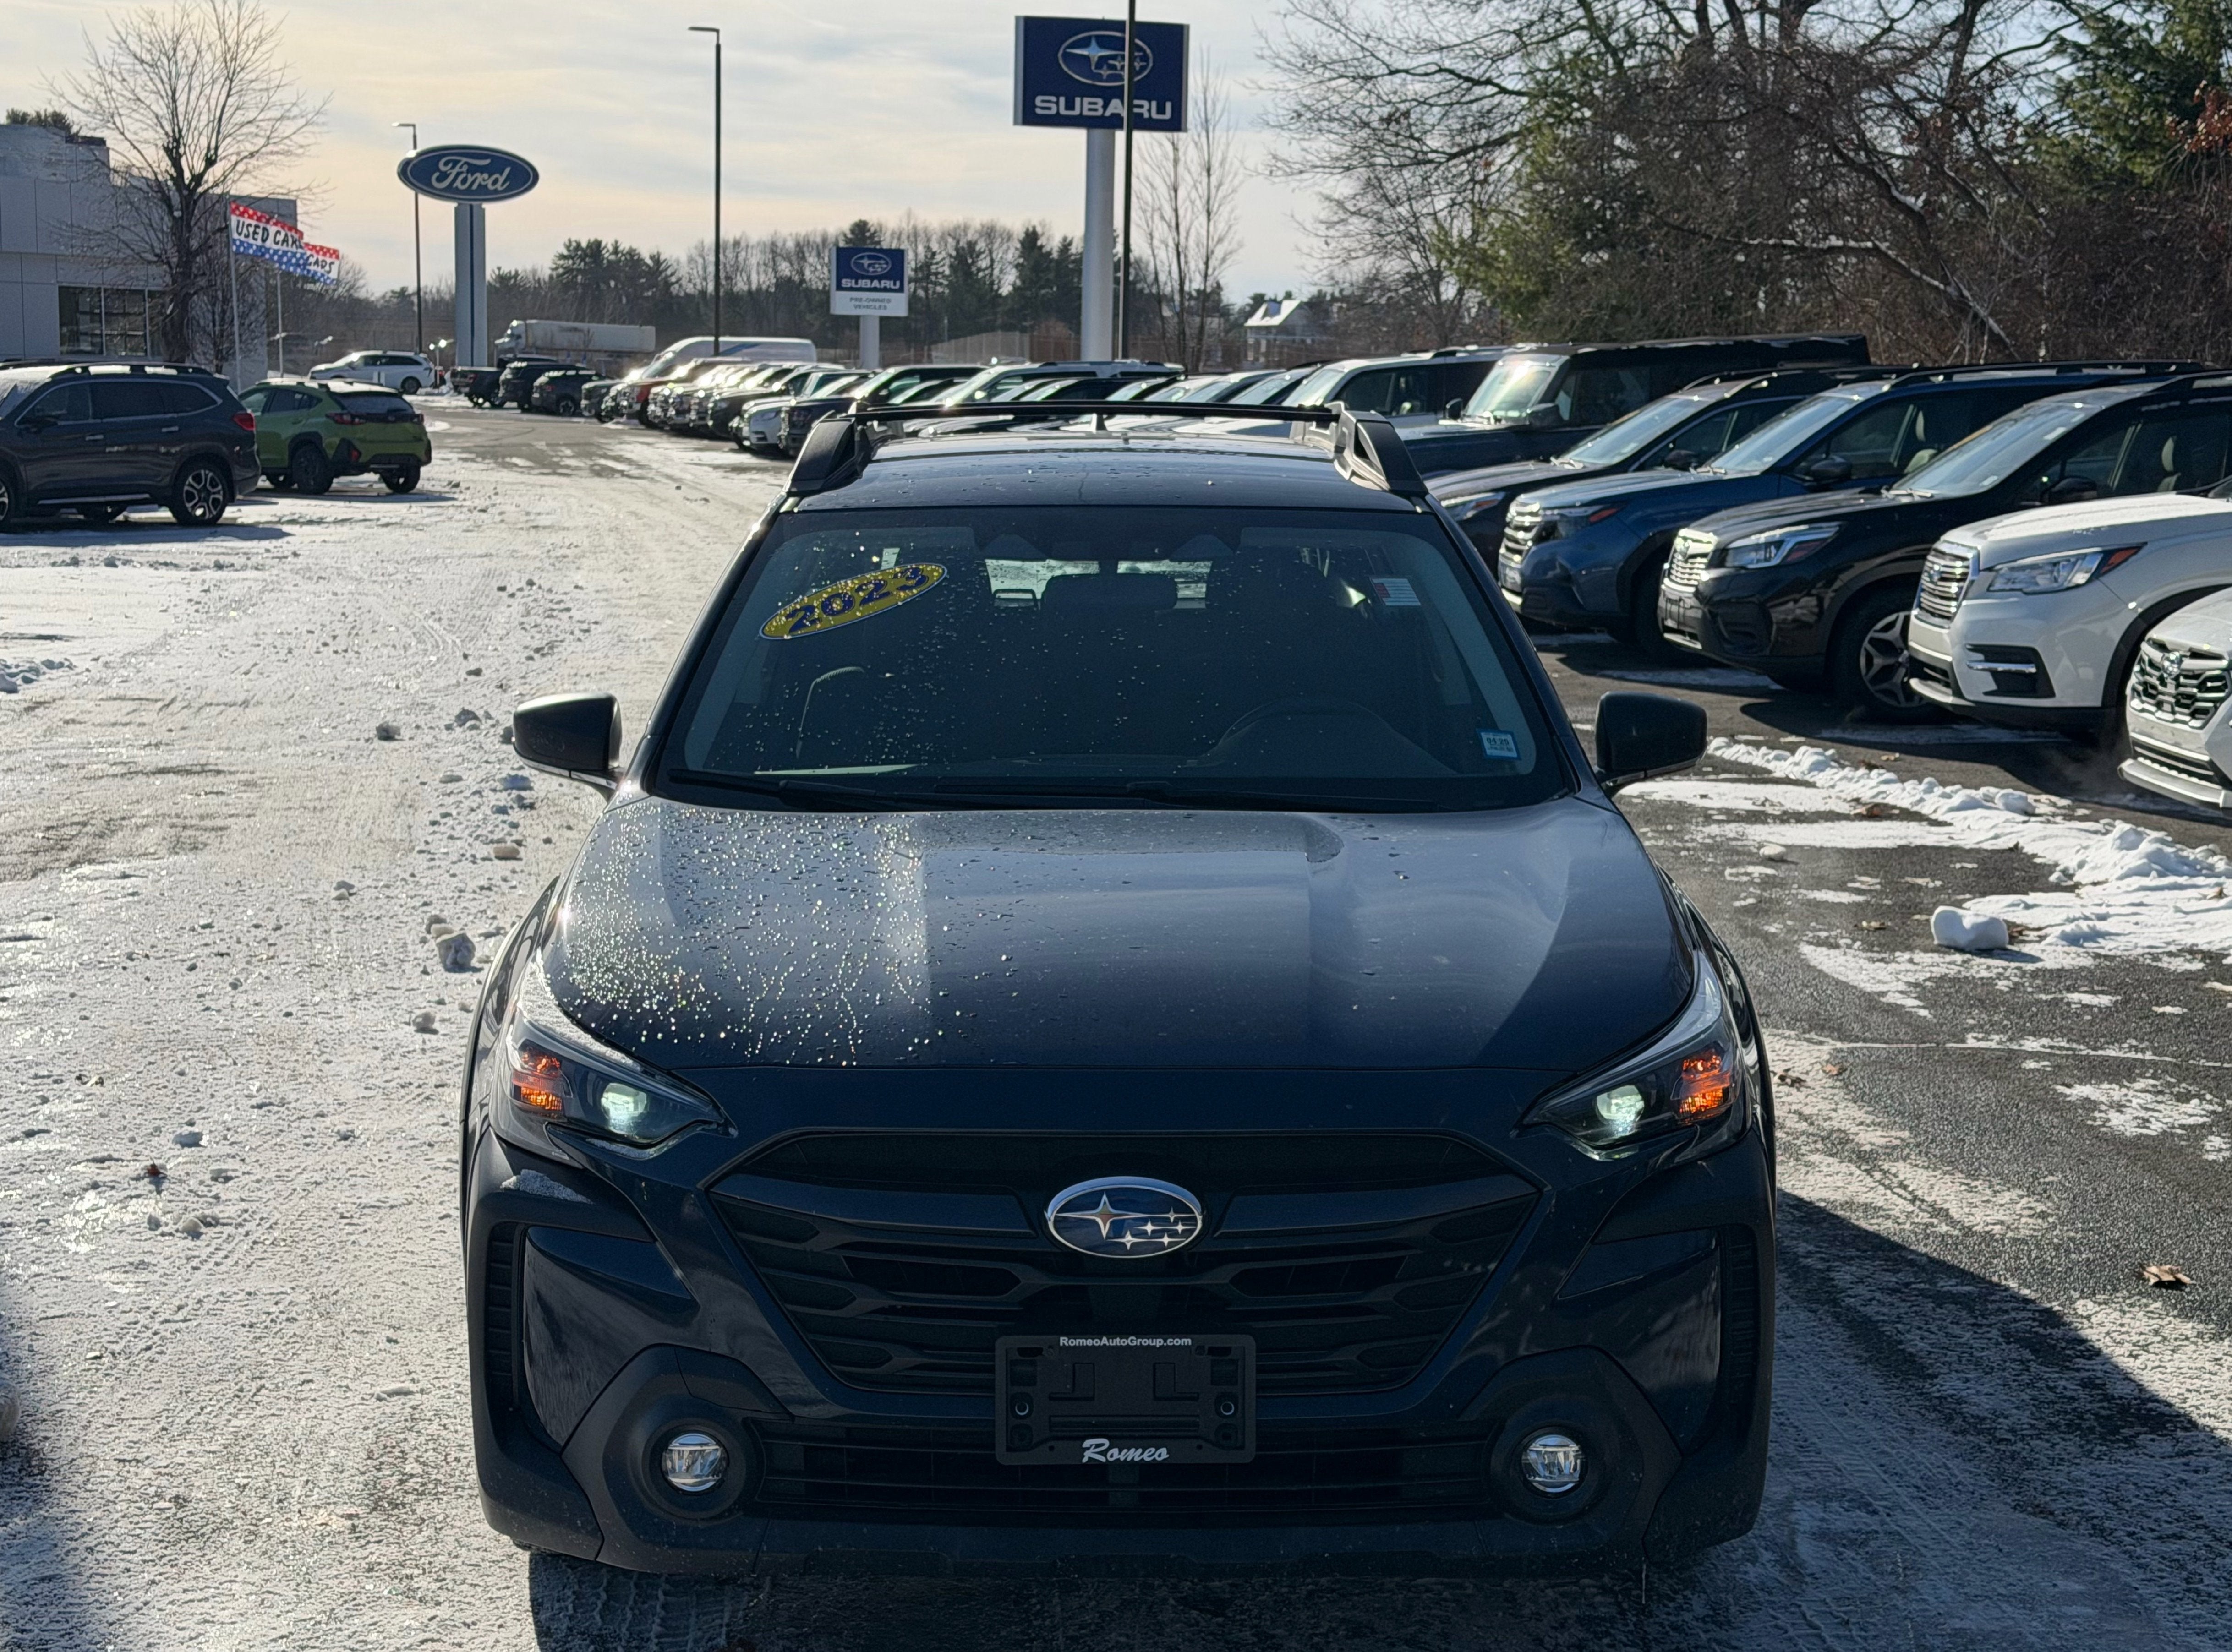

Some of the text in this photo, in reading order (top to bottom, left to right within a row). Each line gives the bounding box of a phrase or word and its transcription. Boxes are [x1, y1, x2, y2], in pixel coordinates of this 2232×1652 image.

[1034, 95, 1171, 120] SUBARU
[431, 156, 511, 191] Ford
[236, 219, 269, 243] USED
[841, 278, 900, 289] SUBARU
[785, 567, 928, 633] 2023
[1060, 1336, 1192, 1347] RomeoAutoGroup.com
[1082, 1438, 1169, 1463] Romeo
